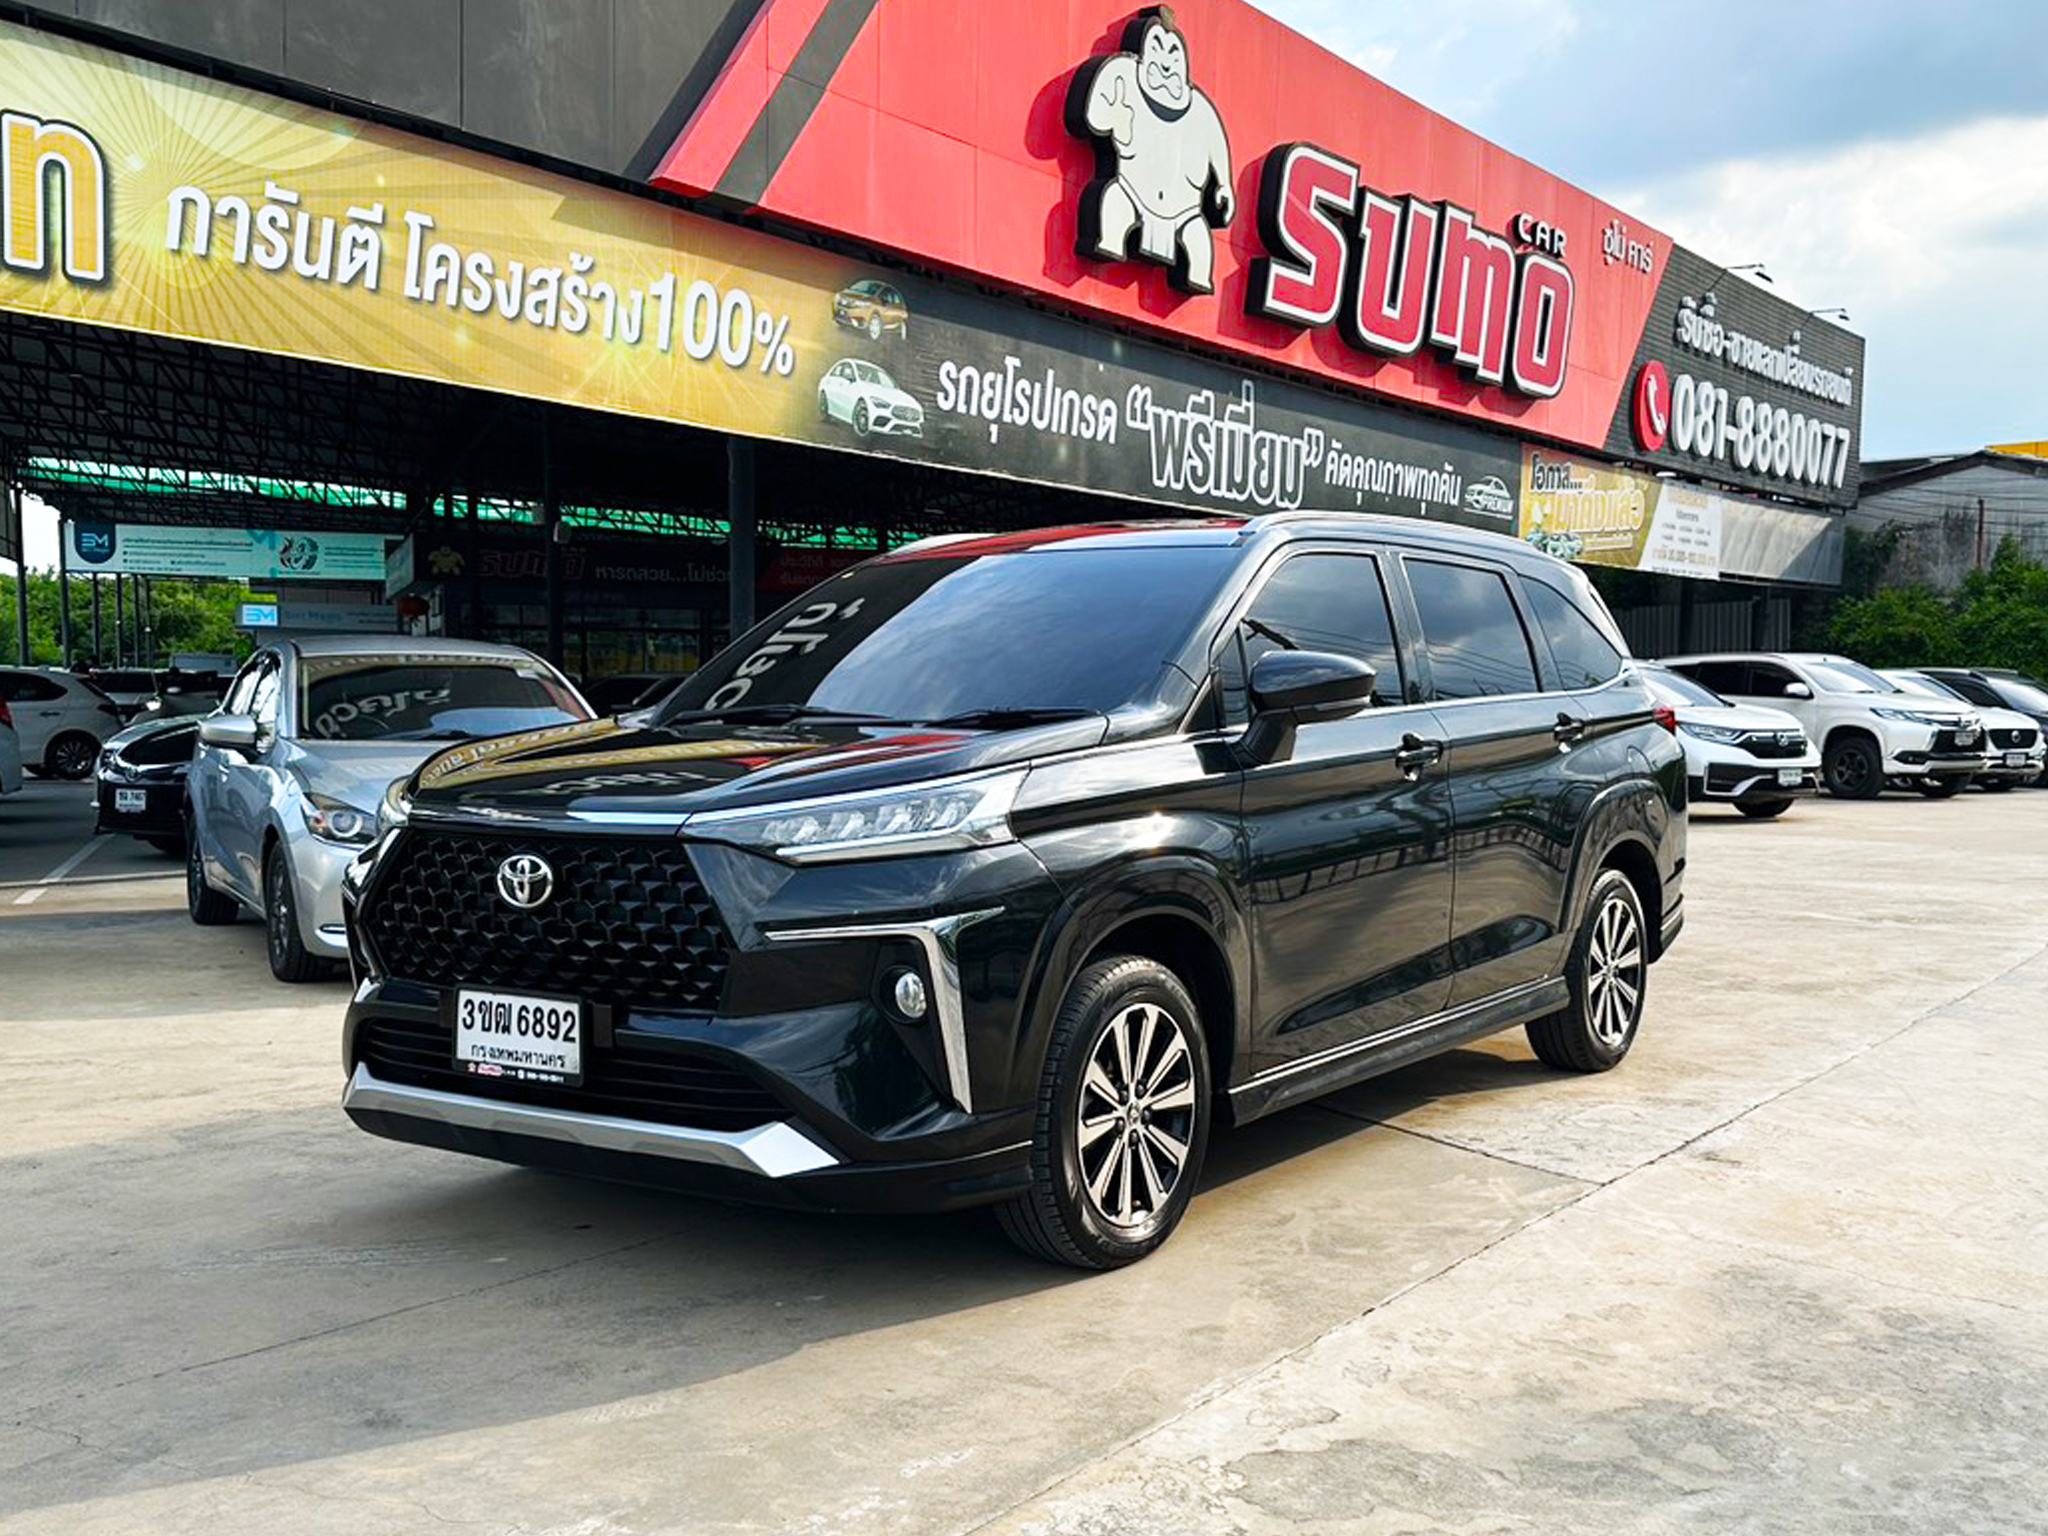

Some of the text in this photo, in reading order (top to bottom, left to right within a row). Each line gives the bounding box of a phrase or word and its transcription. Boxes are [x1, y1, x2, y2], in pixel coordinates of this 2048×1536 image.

[166, 181, 384, 290] การันตี
[1517, 212, 1567, 258] CAR
[1603, 219, 1653, 273] ซูโม่ คาร์
[936, 355, 1119, 444] รถยุโรปเกรด
[1324, 438, 1463, 516] คัดคุณภาพทุกคัน
[1671, 373, 1850, 489] 081-8880077
[516, 1004, 577, 1043] 6892
